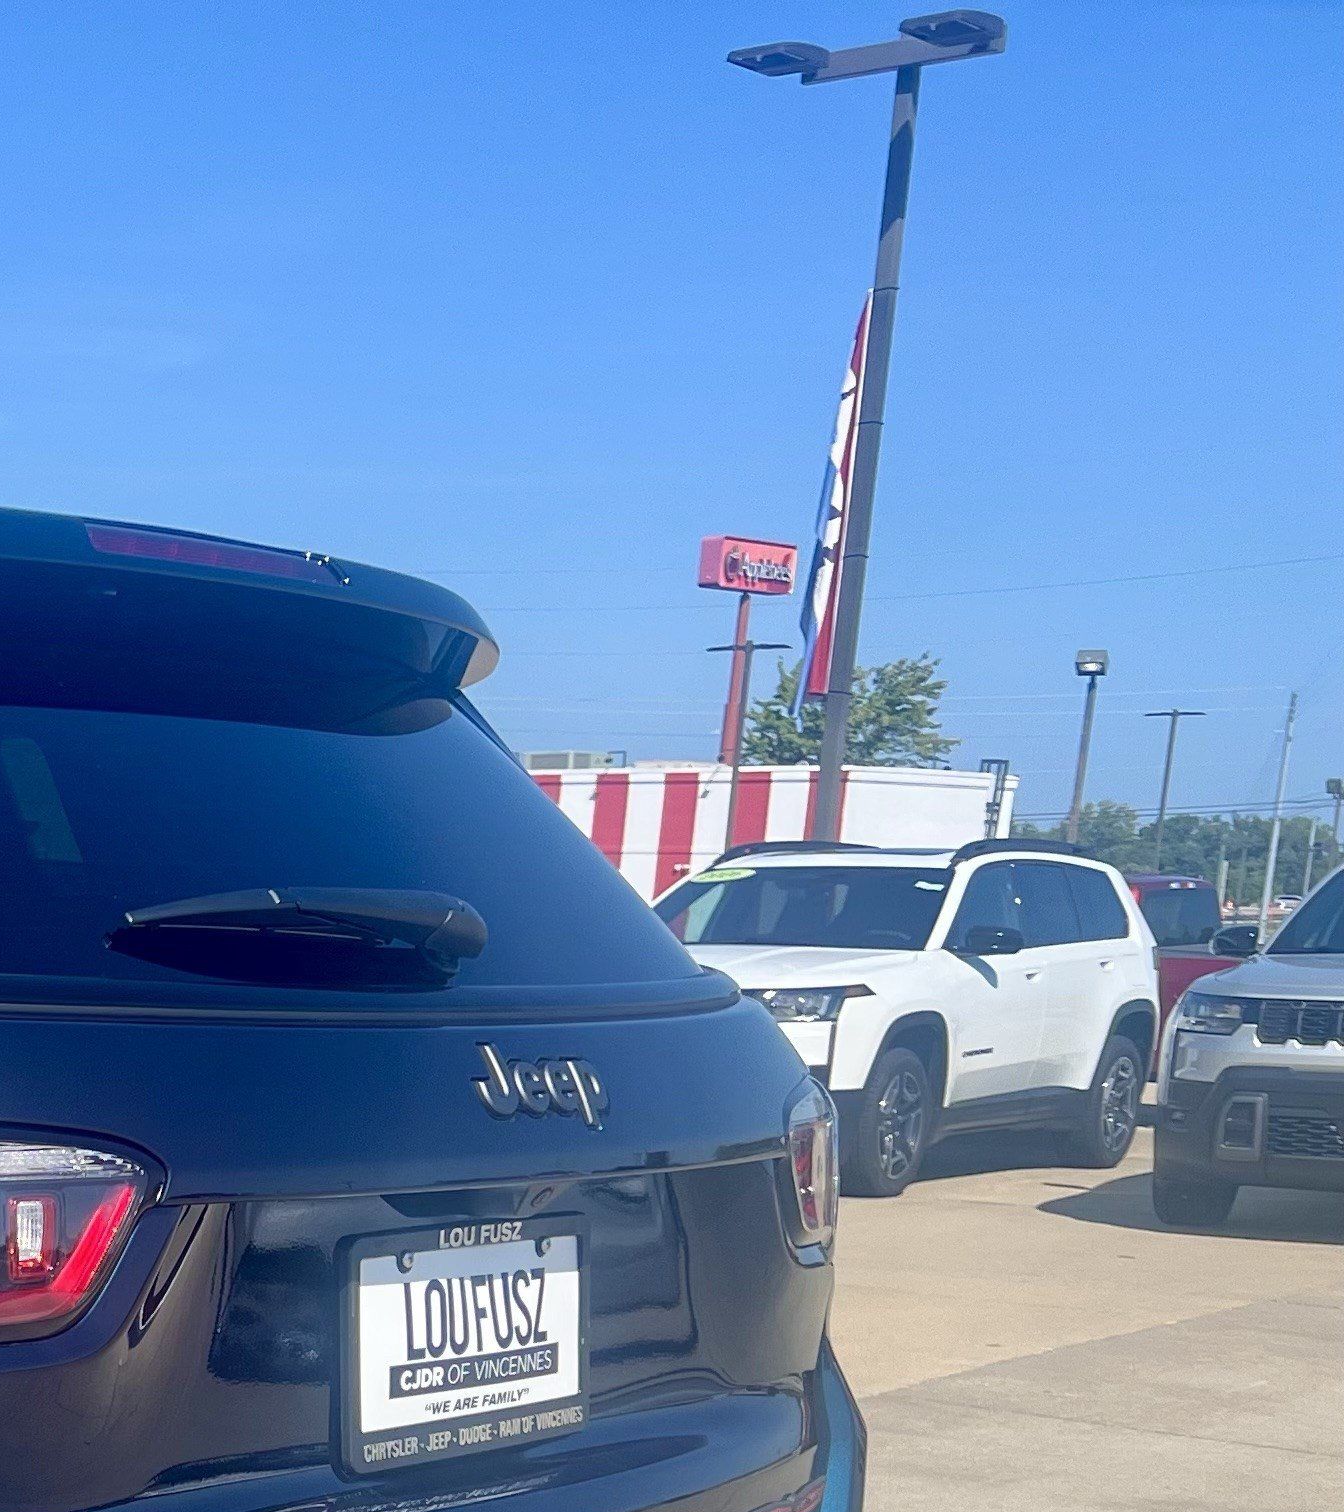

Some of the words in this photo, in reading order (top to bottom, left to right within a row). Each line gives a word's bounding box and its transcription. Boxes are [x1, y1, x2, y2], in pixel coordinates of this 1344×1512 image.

[470, 1041, 609, 1130] Jeep
[439, 1226, 476, 1250] LOU
[480, 1221, 524, 1245] FUSZ
[400, 1366, 444, 1391] CJDR
[447, 1363, 471, 1385] OF
[474, 1350, 553, 1381] VINCENNES
[453, 1397, 479, 1412] ARE
[363, 1436, 419, 1463] CHRYSLER
[425, 1430, 452, 1453] JEEP
[499, 1416, 520, 1440] RAM
[521, 1414, 534, 1434] OF
[535, 1405, 584, 1432] VINCENNES
